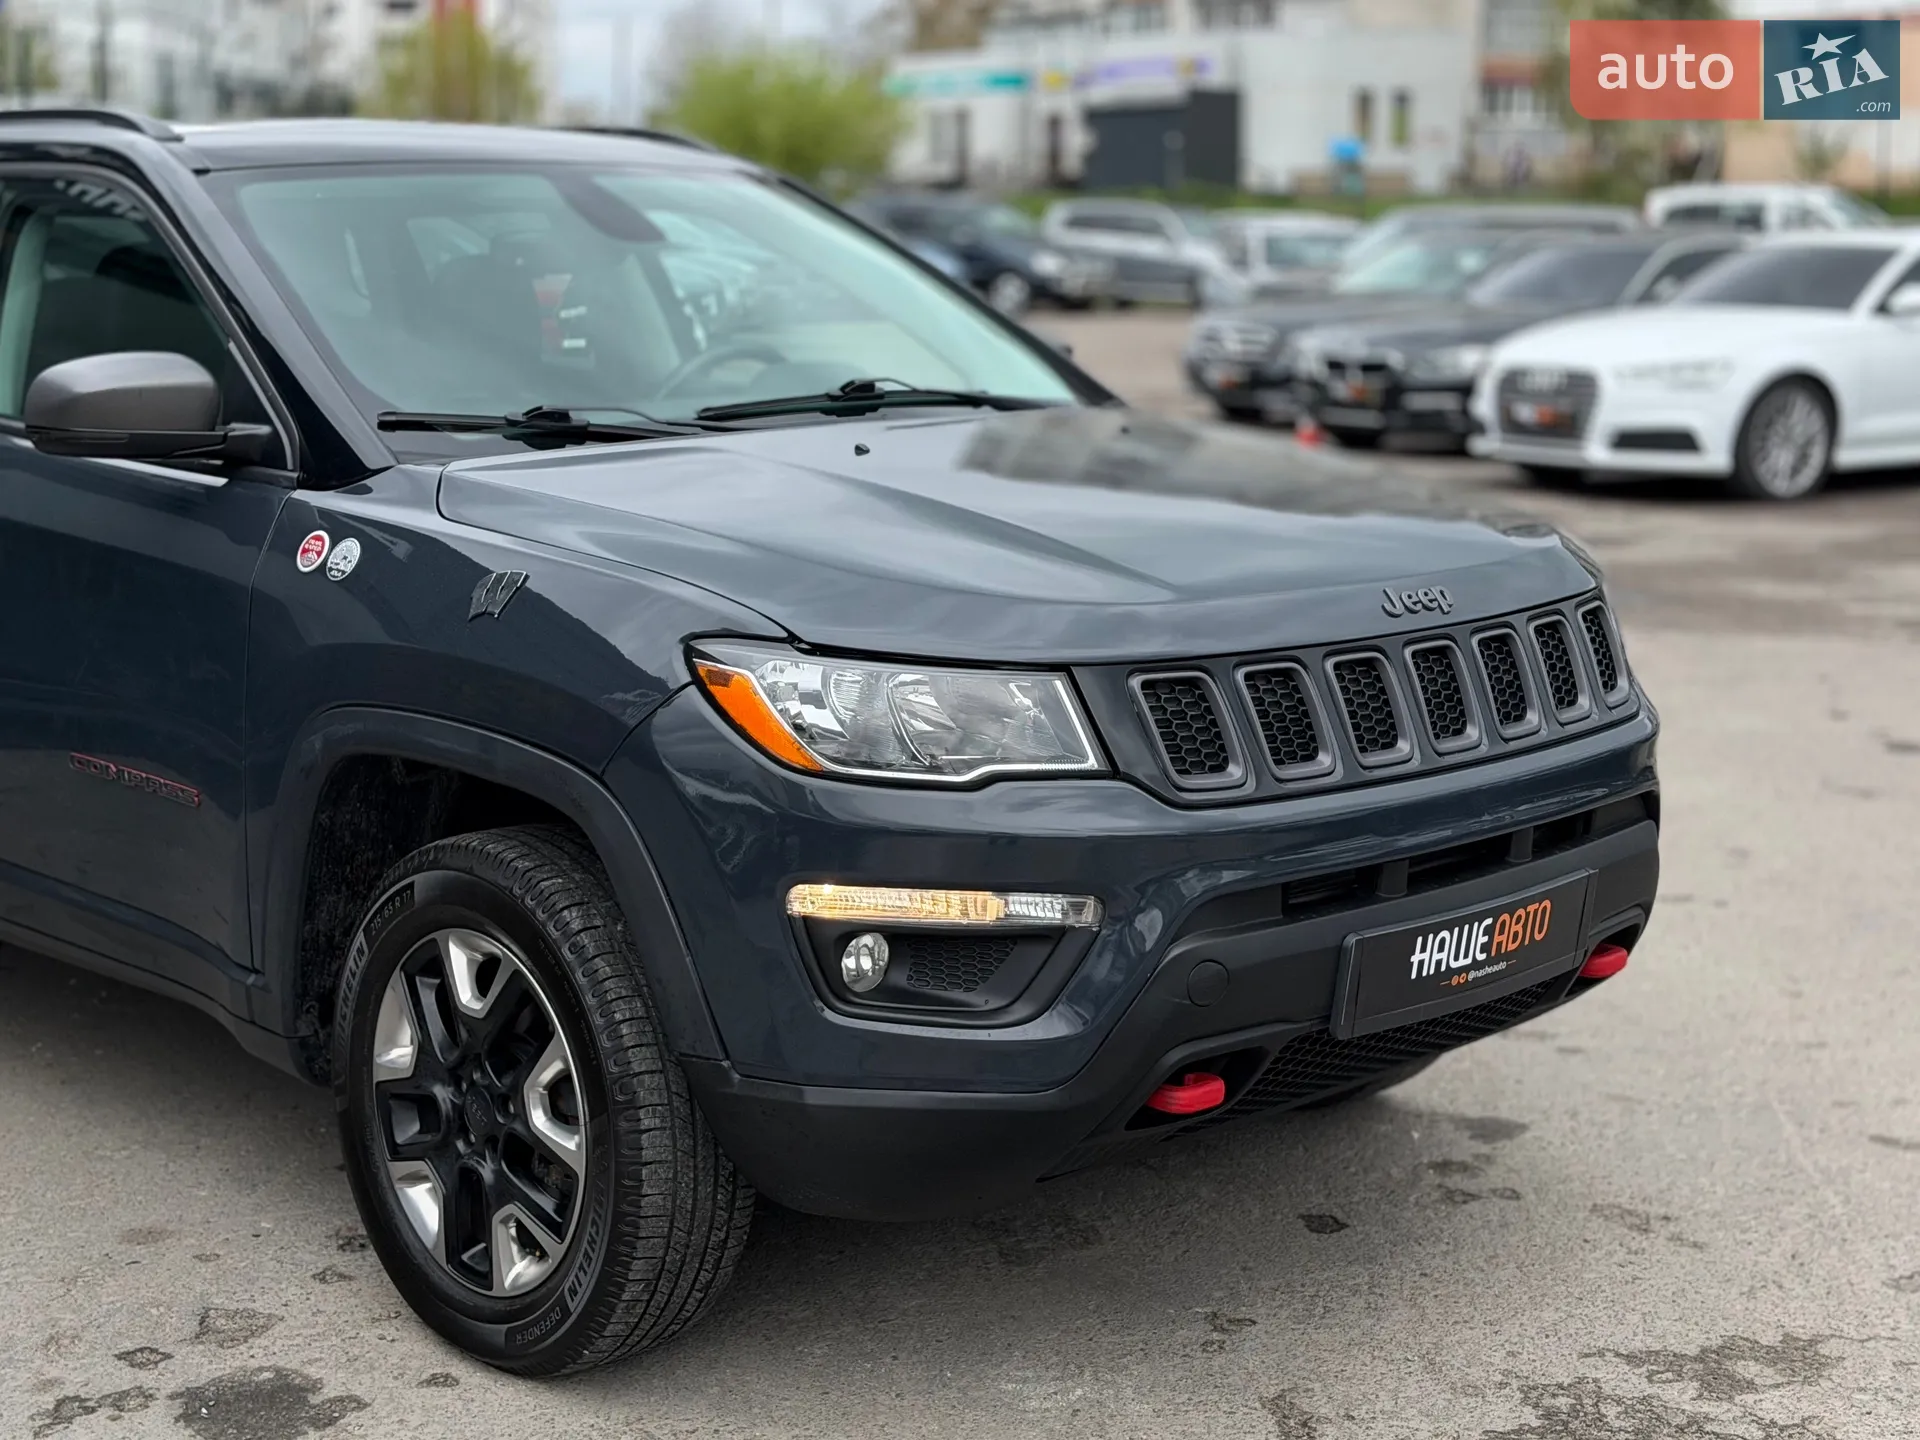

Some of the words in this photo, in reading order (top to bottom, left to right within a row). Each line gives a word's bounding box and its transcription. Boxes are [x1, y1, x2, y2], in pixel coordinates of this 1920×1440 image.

[1381, 585, 1455, 618] Jeep
[69, 752, 201, 807] COMPASS
[1410, 917, 1494, 980] НАШЕ
[1491, 899, 1552, 957] АВТО
[1467, 960, 1507, 981] @nasheauto
[516, 1306, 562, 1344] DEFENDER
